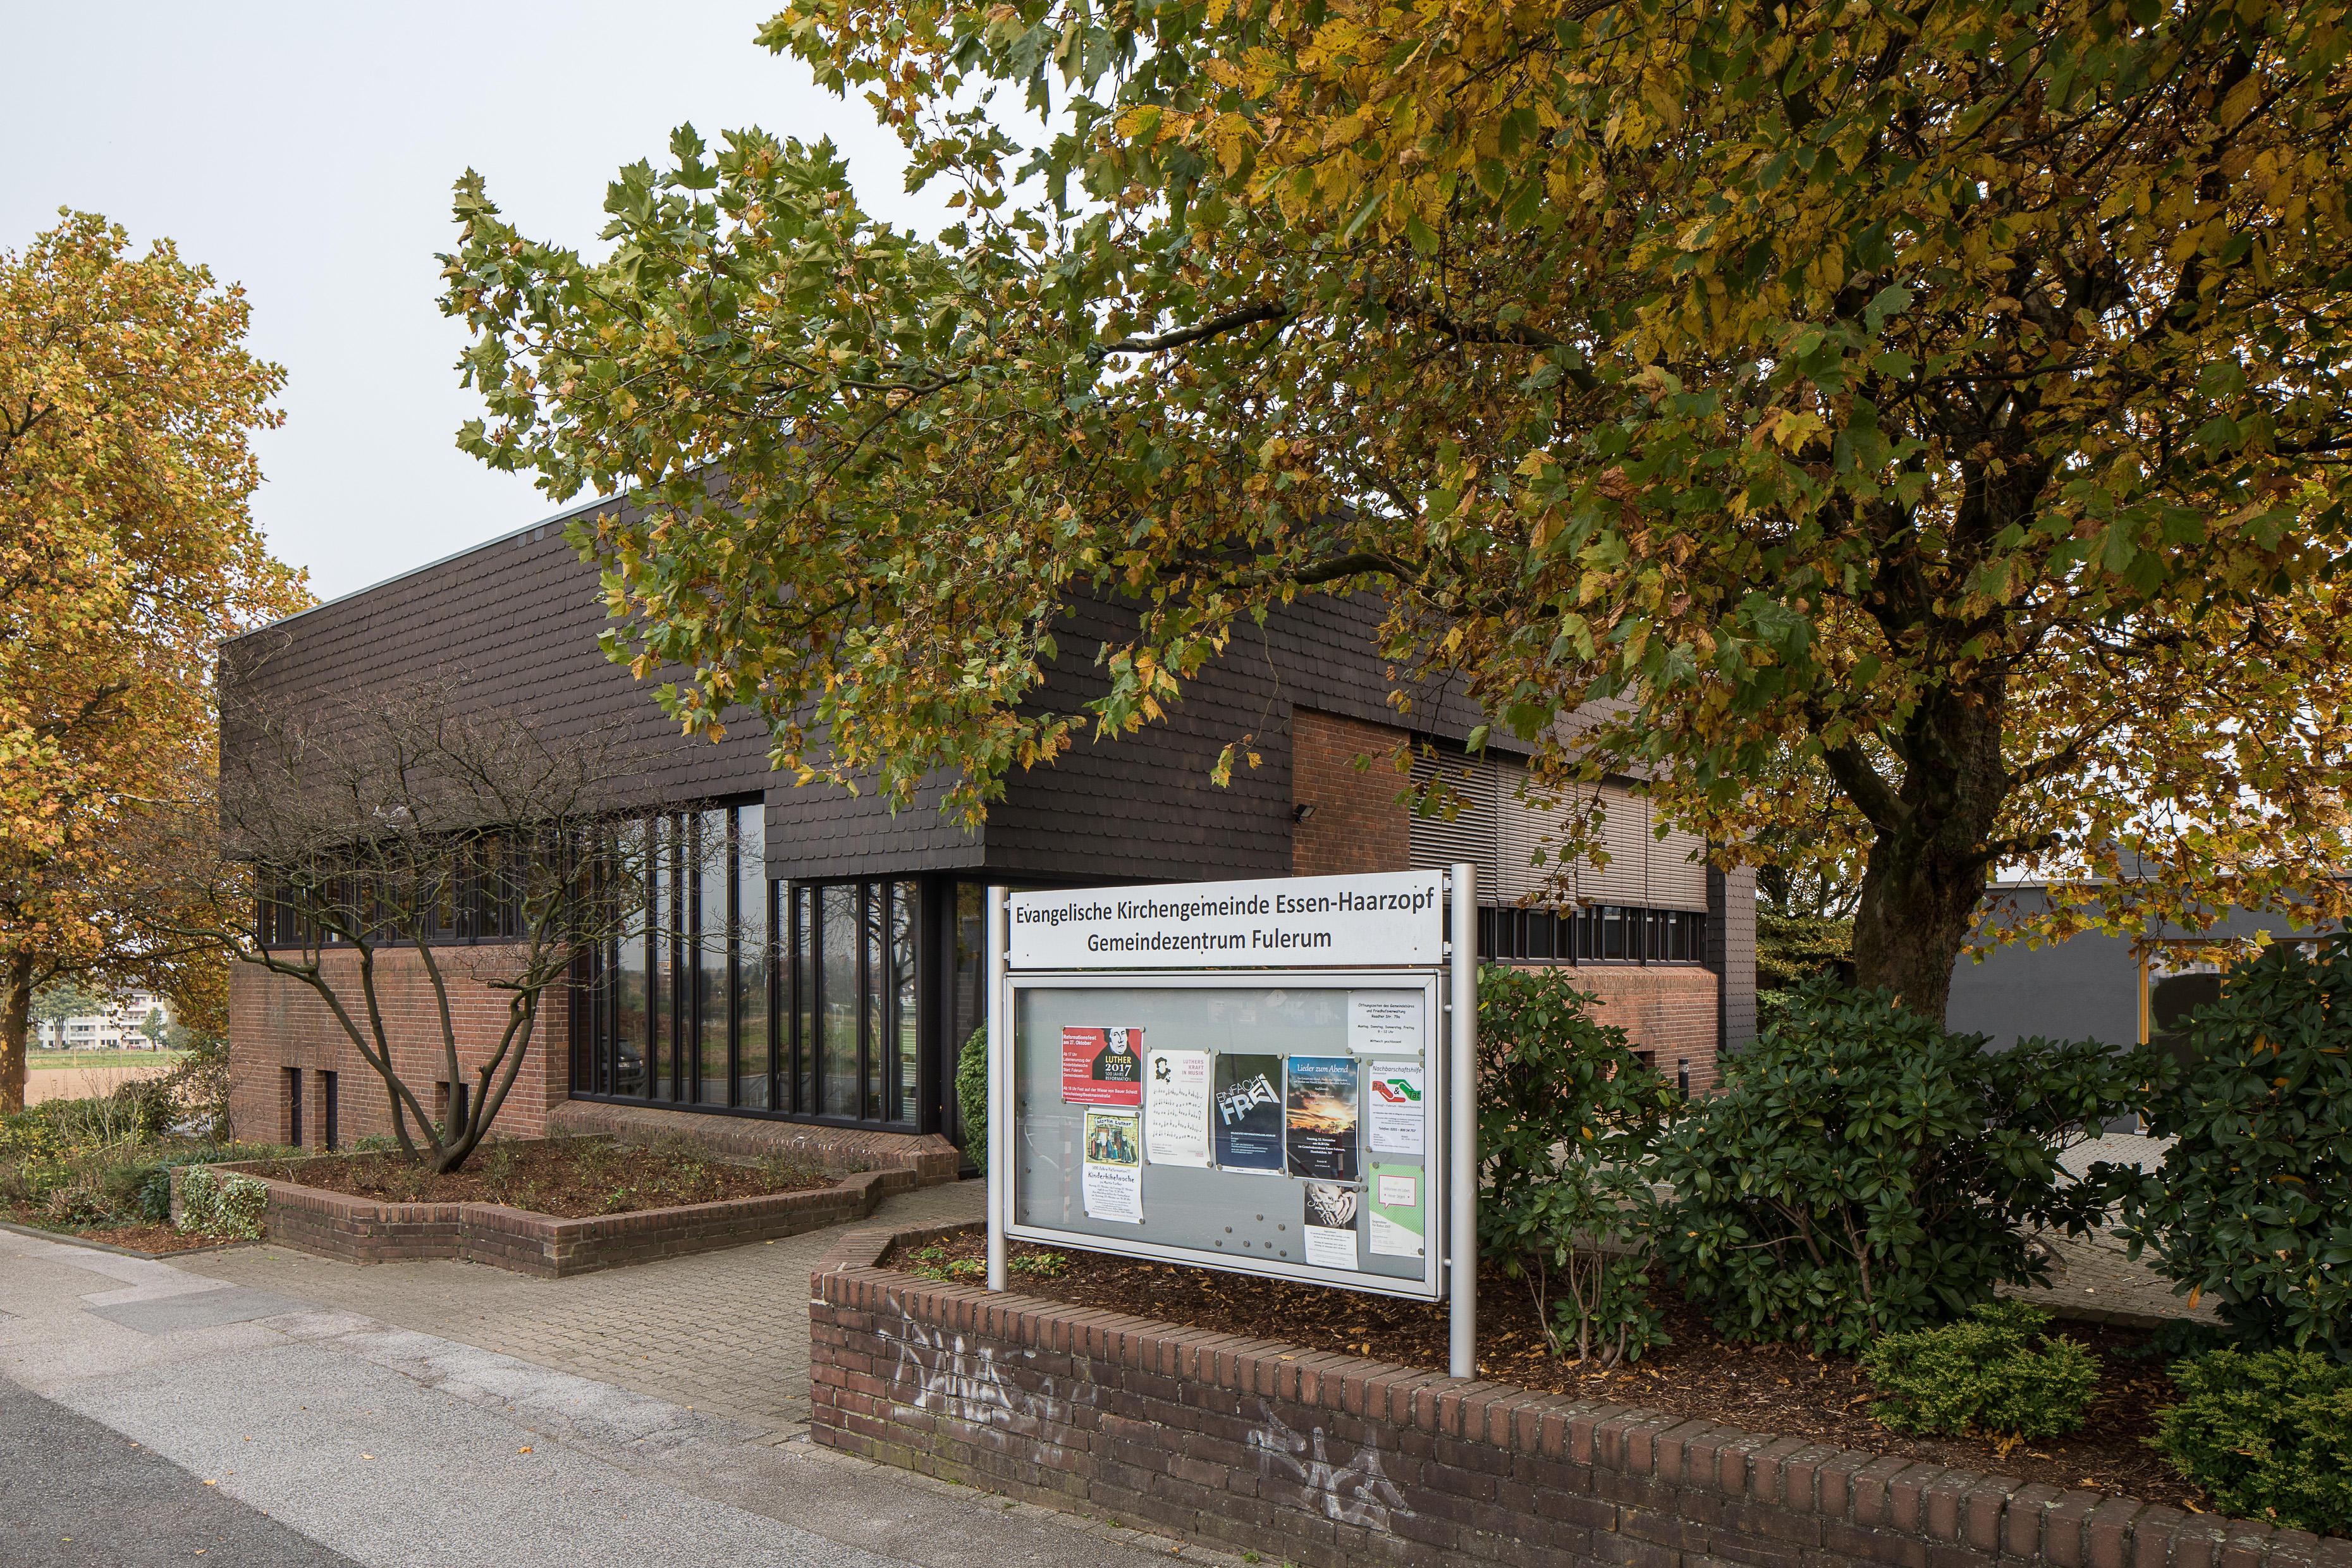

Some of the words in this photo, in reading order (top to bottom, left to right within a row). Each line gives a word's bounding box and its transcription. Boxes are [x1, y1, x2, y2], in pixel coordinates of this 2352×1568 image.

[1016, 902, 1112, 926] Evangelische
[1117, 895, 1270, 921] Kirchengemeinde
[1276, 886, 1435, 914] Essen-Haarzopf
[1087, 931, 1246, 952] Gemeindezentrum
[1253, 928, 1332, 949] Fulerum
[1105, 1063, 1132, 1077] 2017
[1297, 1063, 1314, 1072] Lieder
[1328, 1064, 1348, 1073] Abend
[1373, 1065, 1422, 1074] Nachbarschaftshilfe
[1216, 1075, 1259, 1103] EINFACH
[1409, 1091, 1421, 1099] Tat
[1219, 1073, 1281, 1125] FREI
[1087, 1172, 1134, 1183] Kinderbibelwoche
